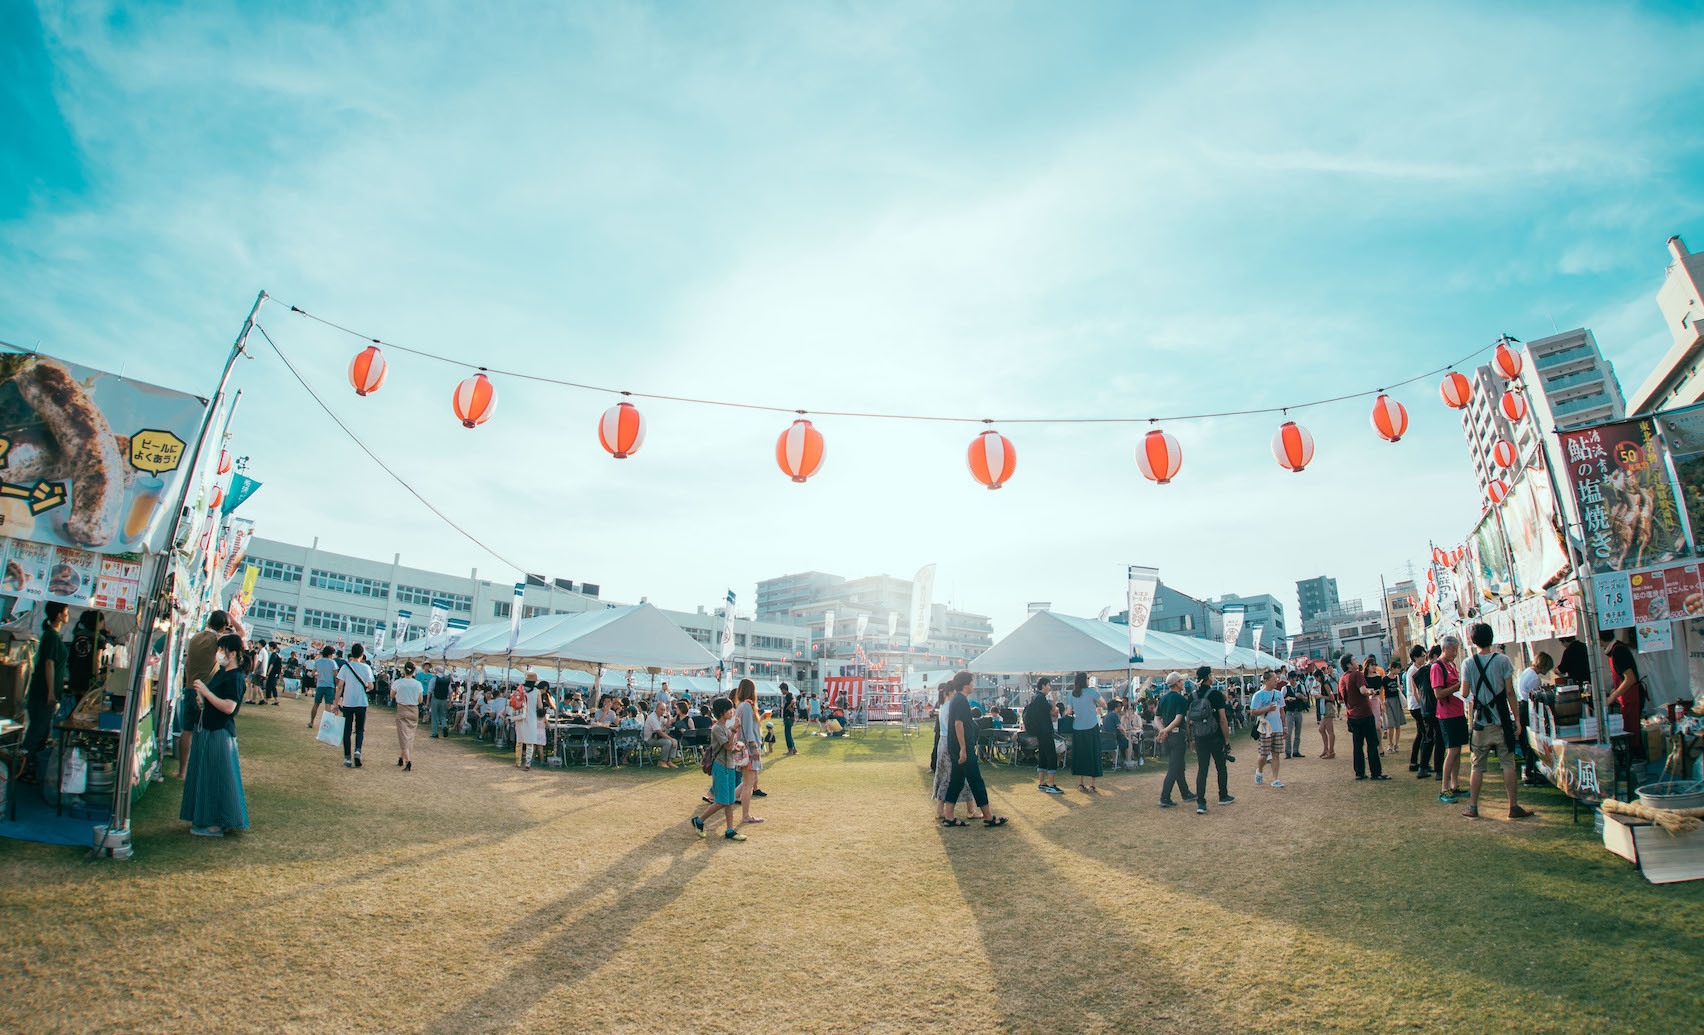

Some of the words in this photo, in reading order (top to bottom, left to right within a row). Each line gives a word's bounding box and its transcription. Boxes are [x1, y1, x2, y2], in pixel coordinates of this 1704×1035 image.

[141, 439, 178, 453] ビールに
[1621, 450, 1636, 463] 50
[1567, 436, 1612, 558] 鮎の塩焼き
[1604, 592, 1623, 607] 7,8
